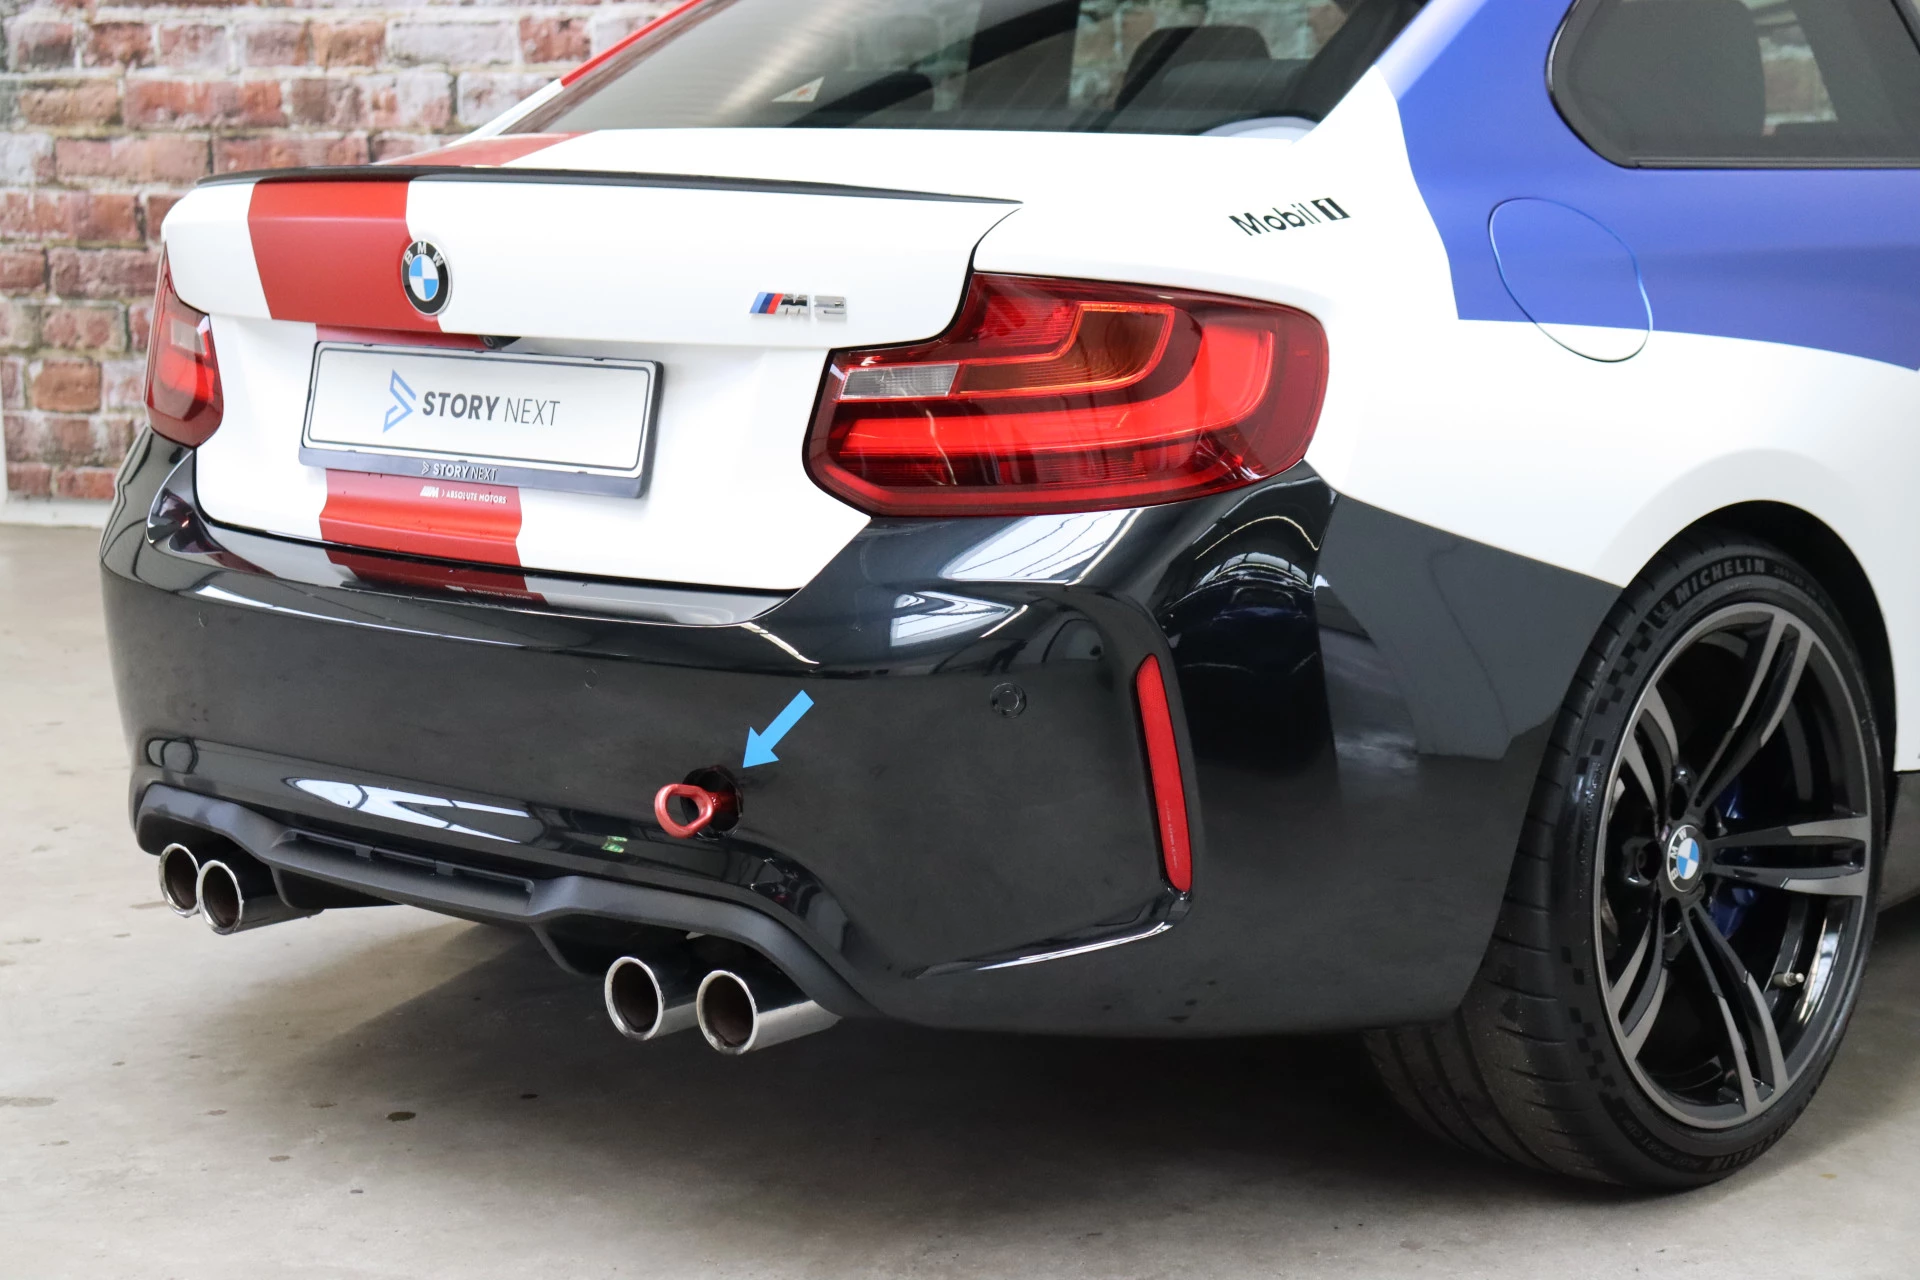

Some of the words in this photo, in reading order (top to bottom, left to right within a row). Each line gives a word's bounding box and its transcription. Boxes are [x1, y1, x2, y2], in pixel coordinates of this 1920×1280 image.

[1228, 202, 1322, 236] Mobil
[1311, 197, 1351, 221] 1
[404, 241, 444, 267] BMW
[422, 391, 500, 421] STORY
[504, 397, 560, 426] NEXT
[433, 463, 470, 479] STORY
[470, 466, 497, 481] NEXT
[446, 490, 477, 501] ABSOLUTE
[479, 494, 506, 504] MOTORS
[1674, 558, 1765, 605] MICHELIN
[1670, 828, 1687, 881] BMW
